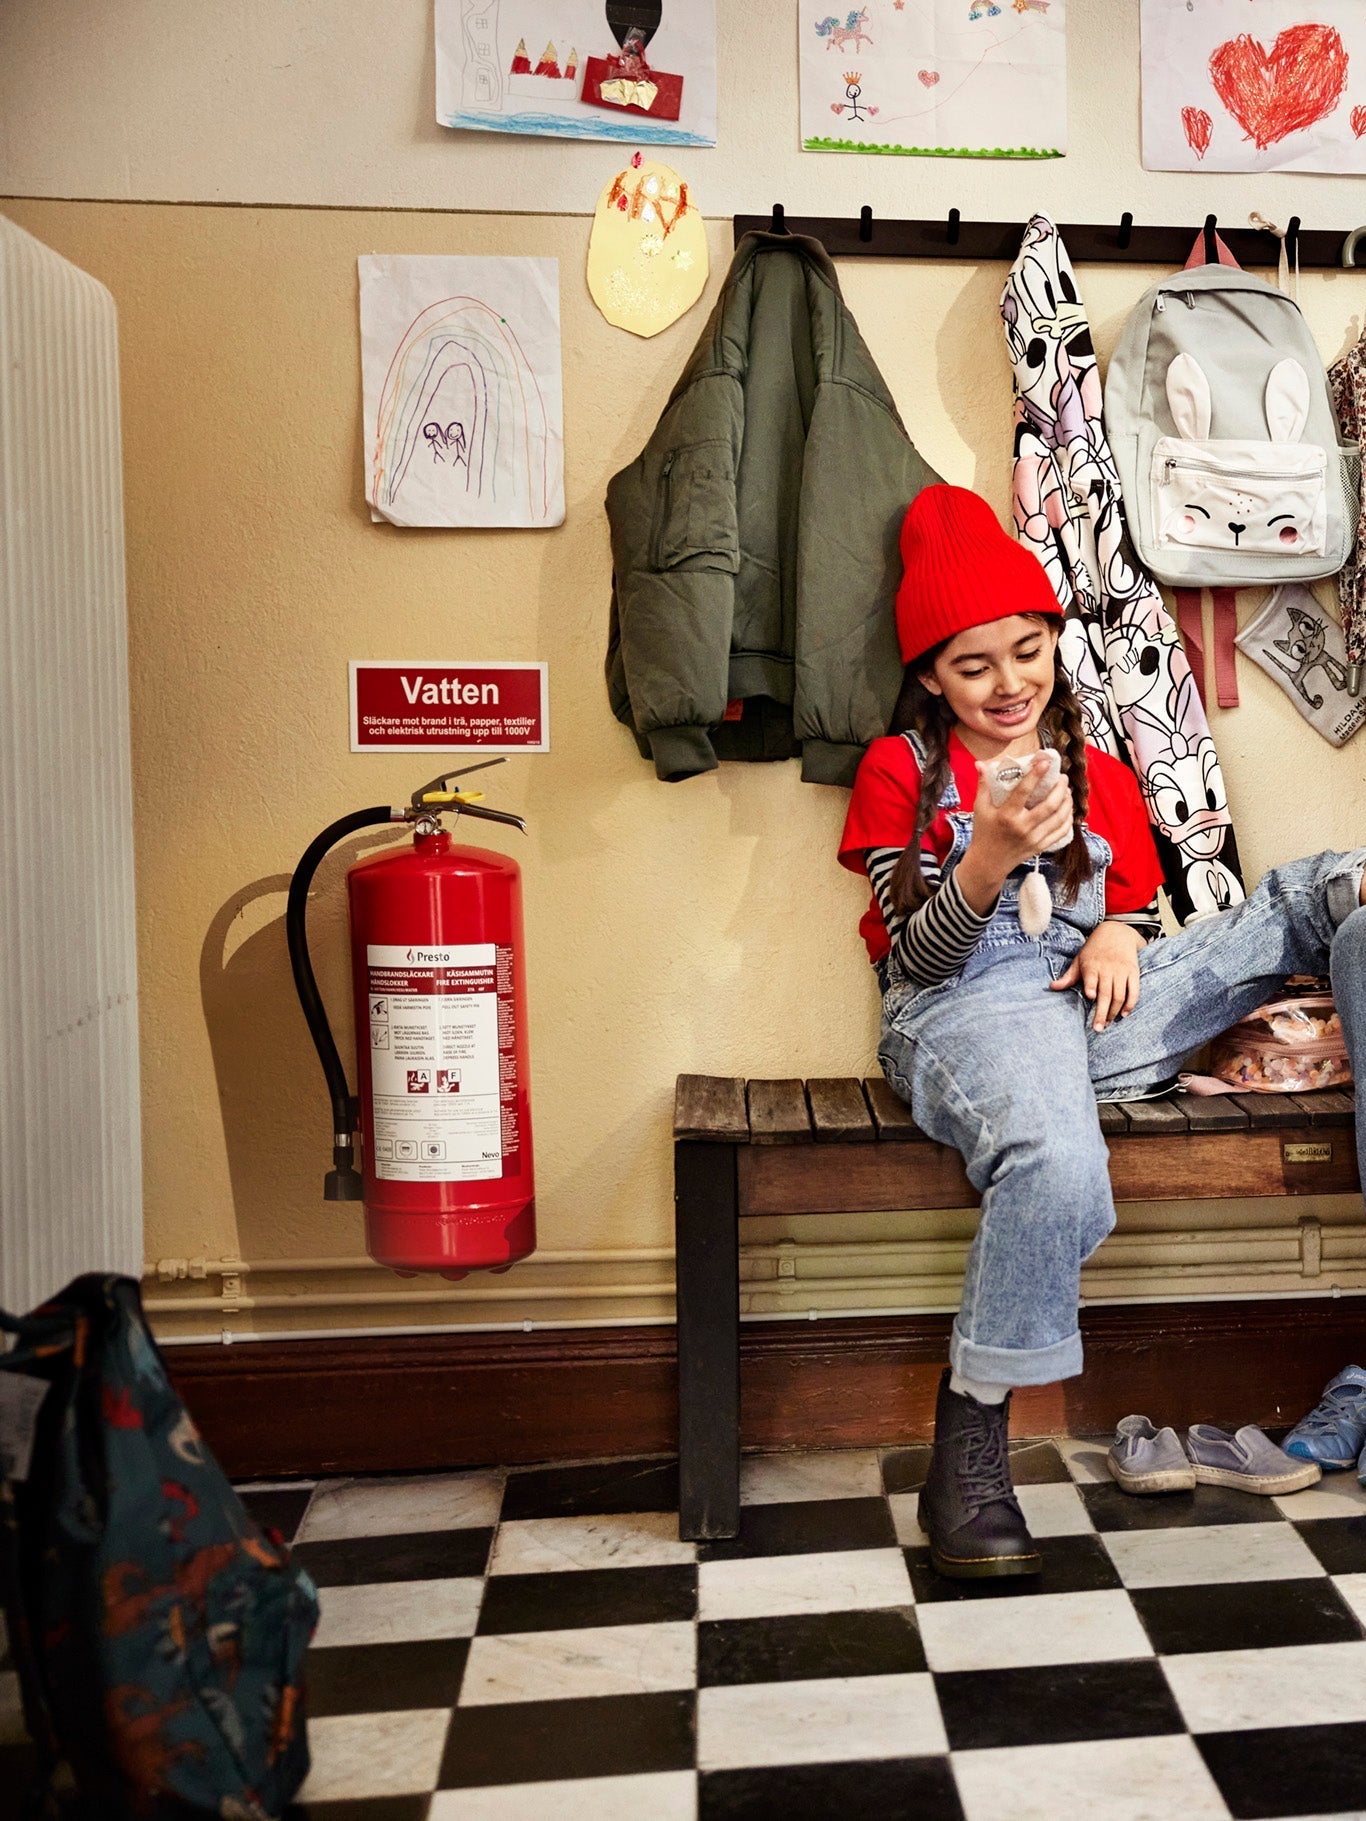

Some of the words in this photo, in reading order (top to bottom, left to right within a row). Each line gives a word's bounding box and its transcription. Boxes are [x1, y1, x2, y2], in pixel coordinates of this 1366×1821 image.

[400, 676, 499, 705] Vatten
[363, 716, 401, 725] Släckare
[403, 716, 420, 725] mot
[421, 716, 447, 725] brand
[469, 718, 502, 727] papper,
[503, 717, 536, 726] textilier
[369, 727, 386, 735] och
[387, 727, 425, 735] elektrisk
[426, 727, 471, 737] utrustning
[472, 728, 490, 737] upp
[491, 727, 502, 735] till
[504, 727, 531, 735] 1000V
[417, 952, 450, 961] Presto
[446, 969, 494, 977] KÄSISAMMUTIN
[451, 977, 495, 986] EXTINGUISHER
[420, 1072, 428, 1080] A
